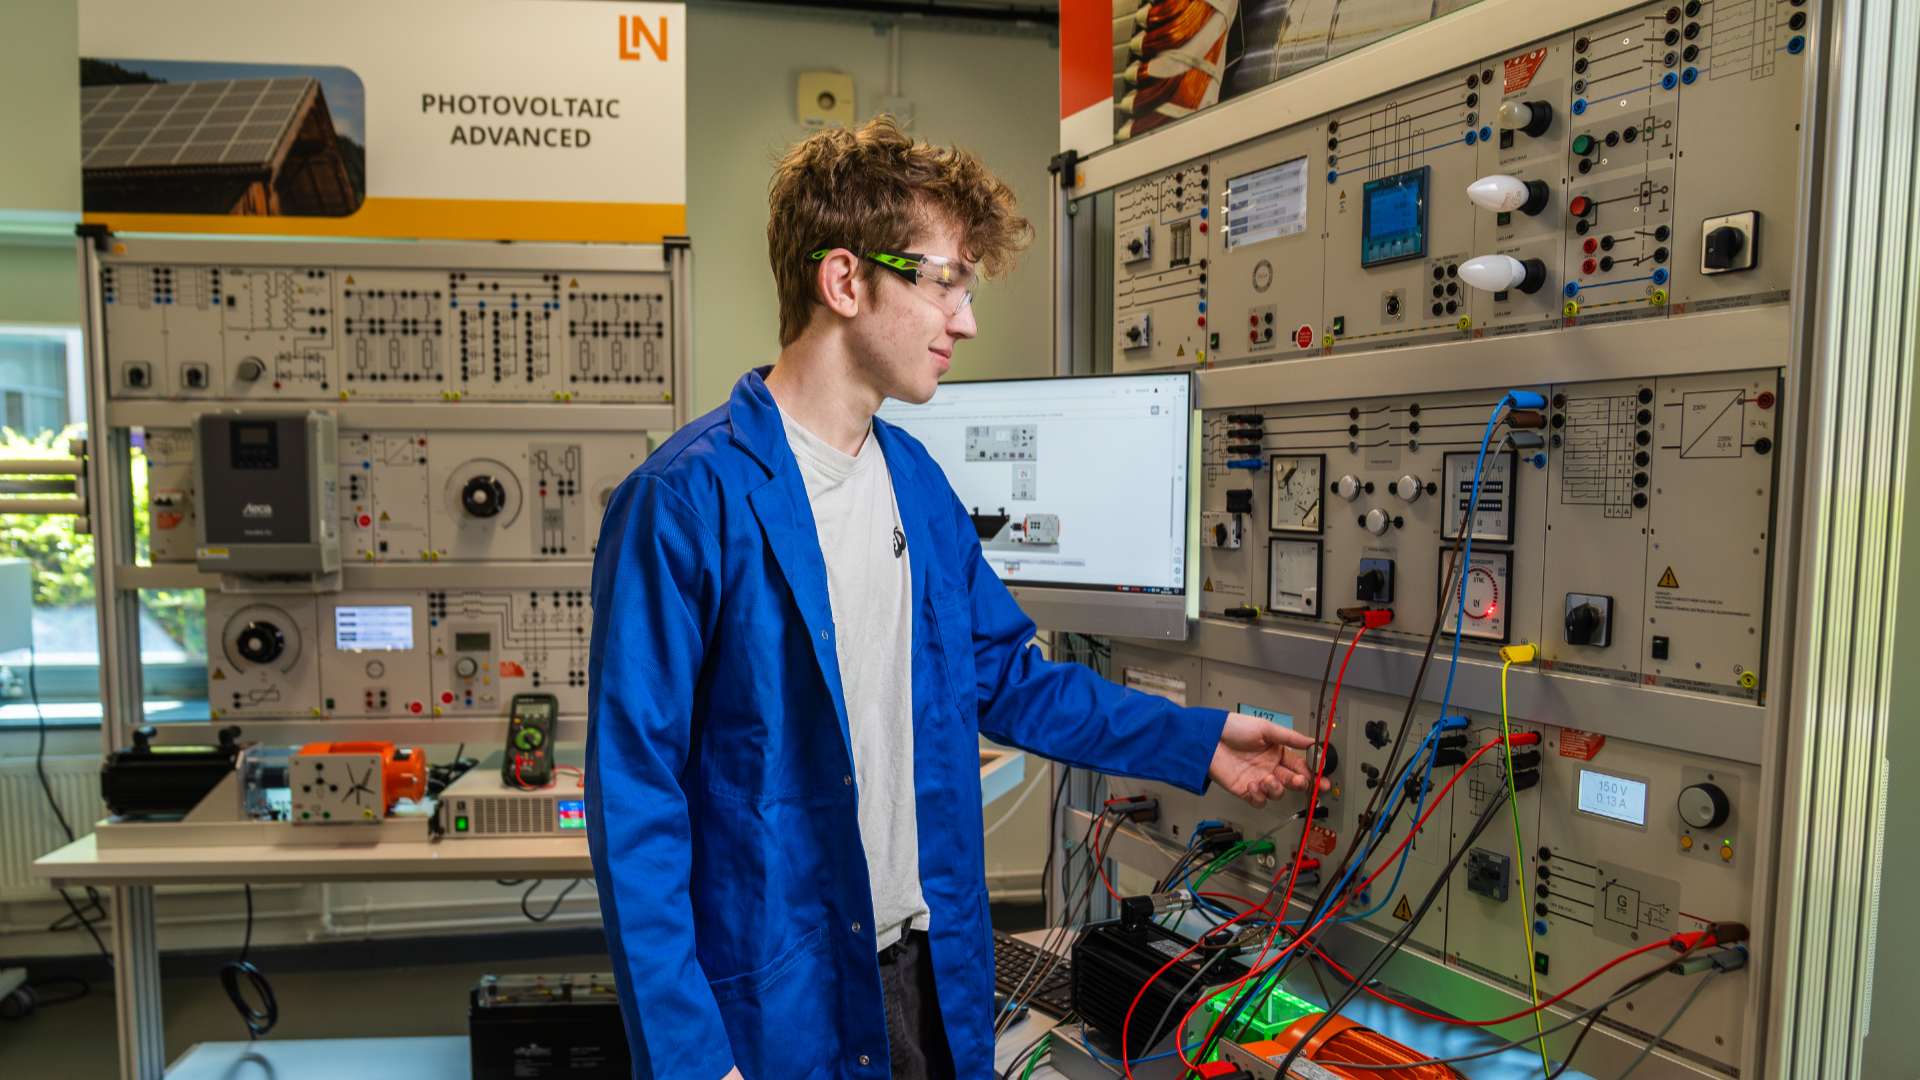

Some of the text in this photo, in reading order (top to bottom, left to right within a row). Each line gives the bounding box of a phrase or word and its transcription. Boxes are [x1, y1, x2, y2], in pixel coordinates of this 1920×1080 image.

[421, 93, 621, 119] PHOTOVOLTAIC
[450, 125, 591, 148] ADVANCED
[1620, 783, 1628, 796] V
[1619, 798, 1627, 809] A
[1617, 894, 1628, 908] G
